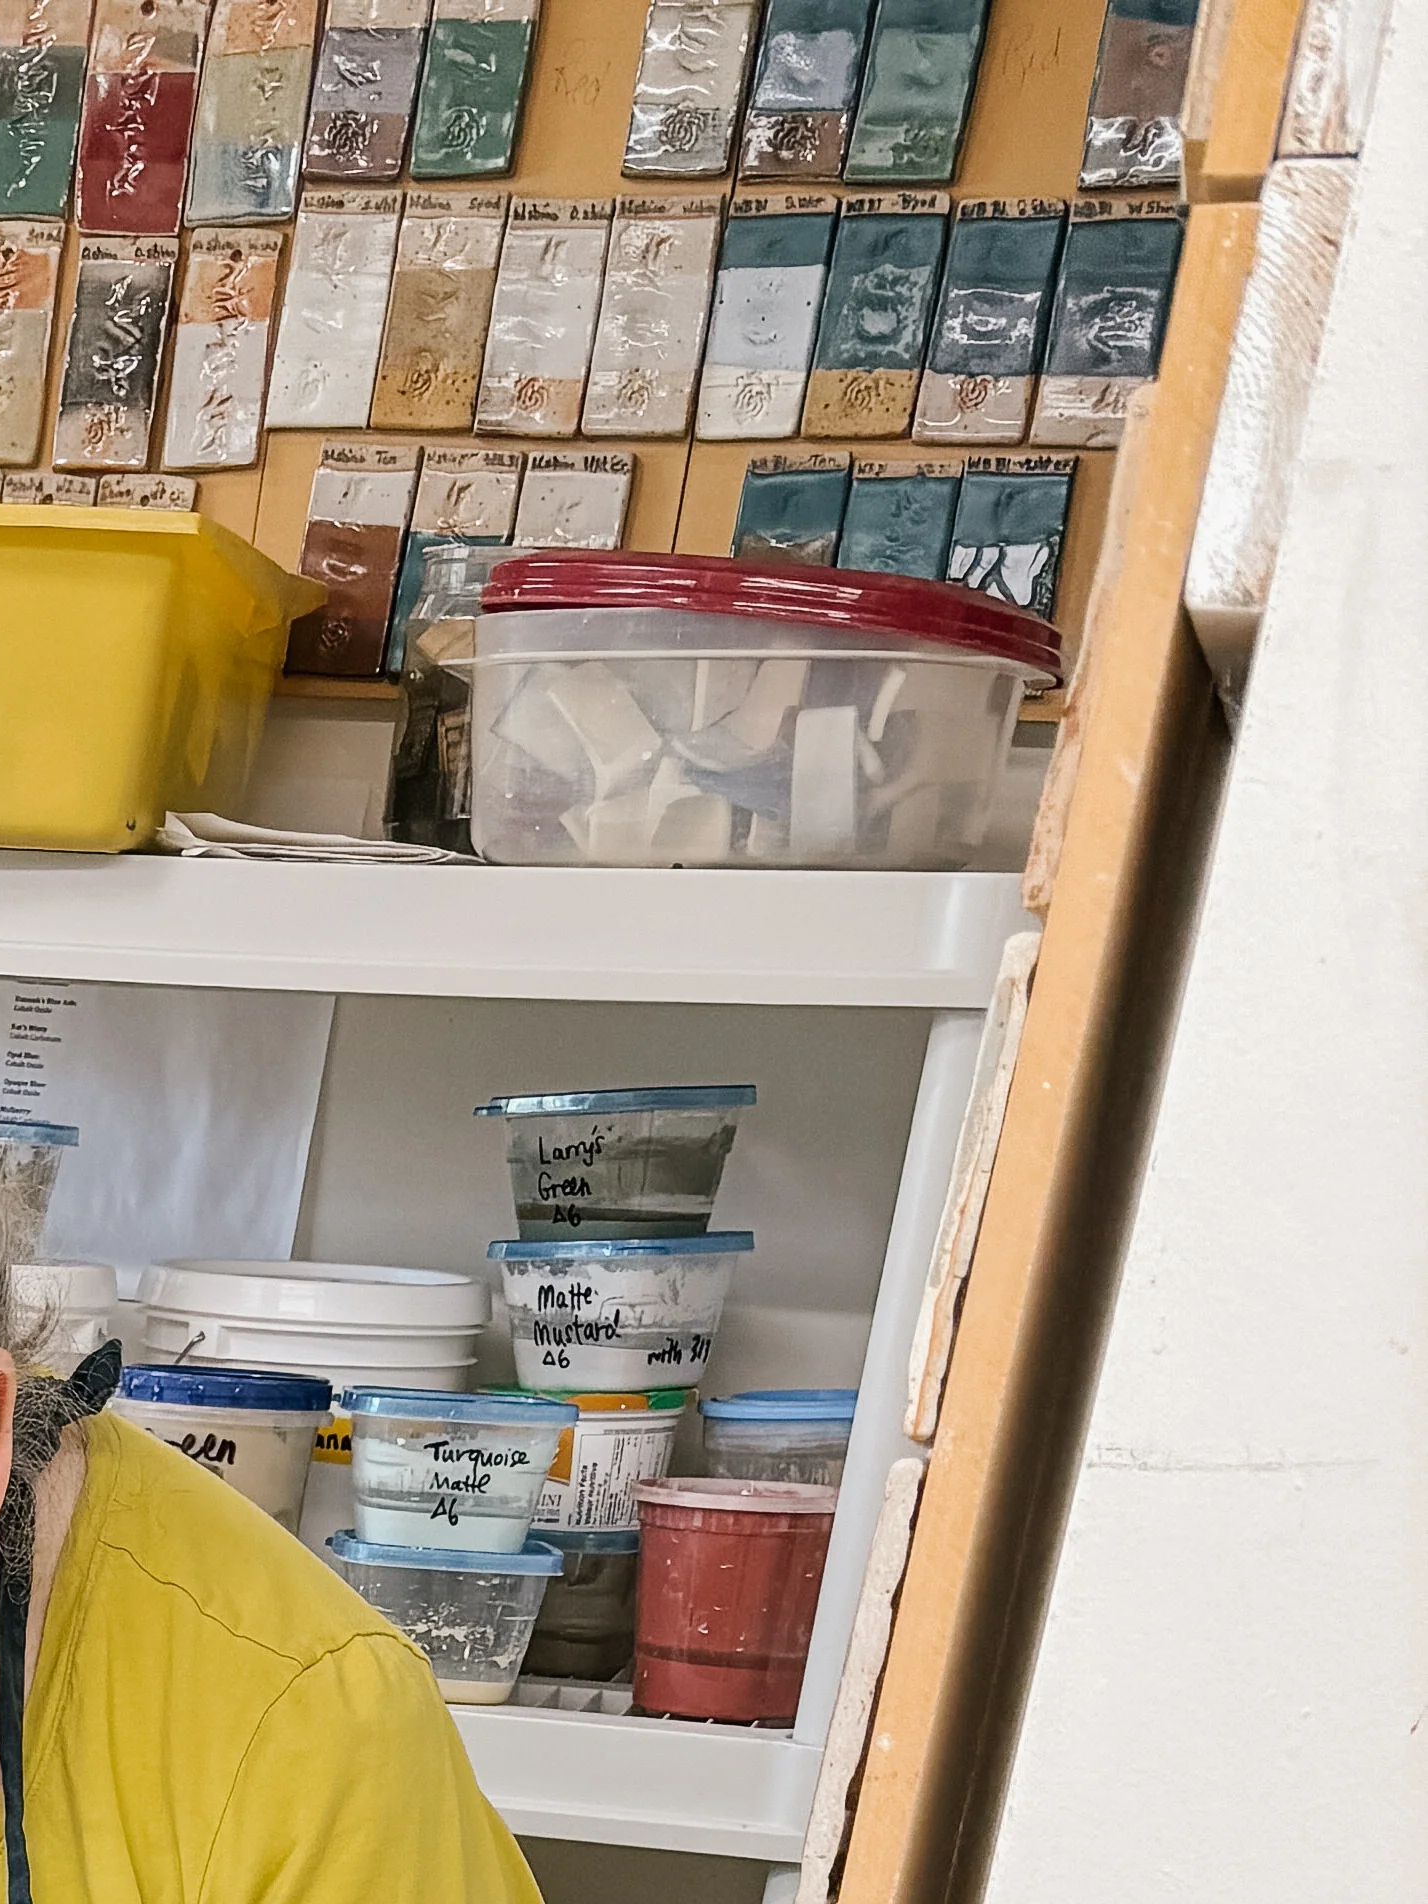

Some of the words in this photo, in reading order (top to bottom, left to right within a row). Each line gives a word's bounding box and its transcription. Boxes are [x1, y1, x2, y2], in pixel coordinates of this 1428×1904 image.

[539, 1125, 605, 1166] Larry's
[538, 1172, 592, 1201] Green
[538, 1282, 593, 1311] Matte
[533, 1309, 622, 1347] Mustard
[424, 1440, 530, 1482] Turquoise
[429, 1472, 491, 1494] Matte
